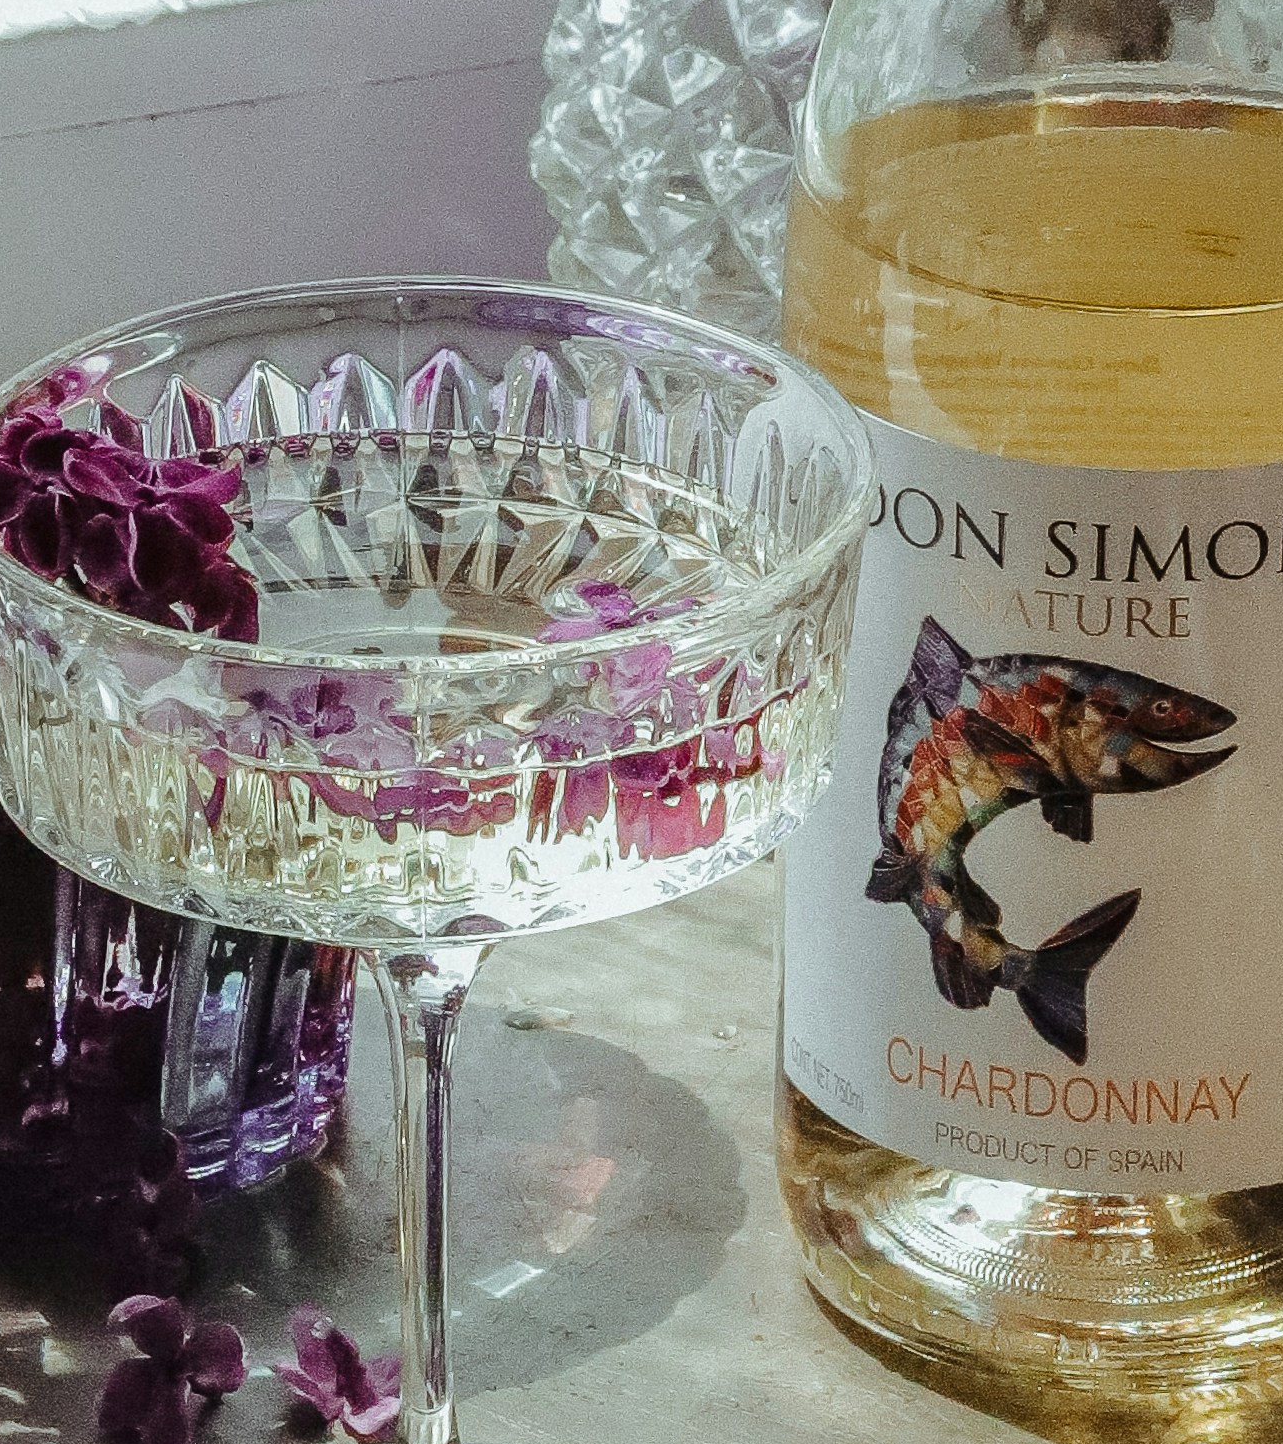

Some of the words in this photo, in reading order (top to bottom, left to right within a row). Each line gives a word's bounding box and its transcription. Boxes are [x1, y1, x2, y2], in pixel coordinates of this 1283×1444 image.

[886, 1035, 1252, 1125] CHARDONNAY
[935, 1121, 1056, 1165] PRODUCT
[1064, 1146, 1102, 1170] OF
[1112, 1148, 1184, 1173] SPAIN
